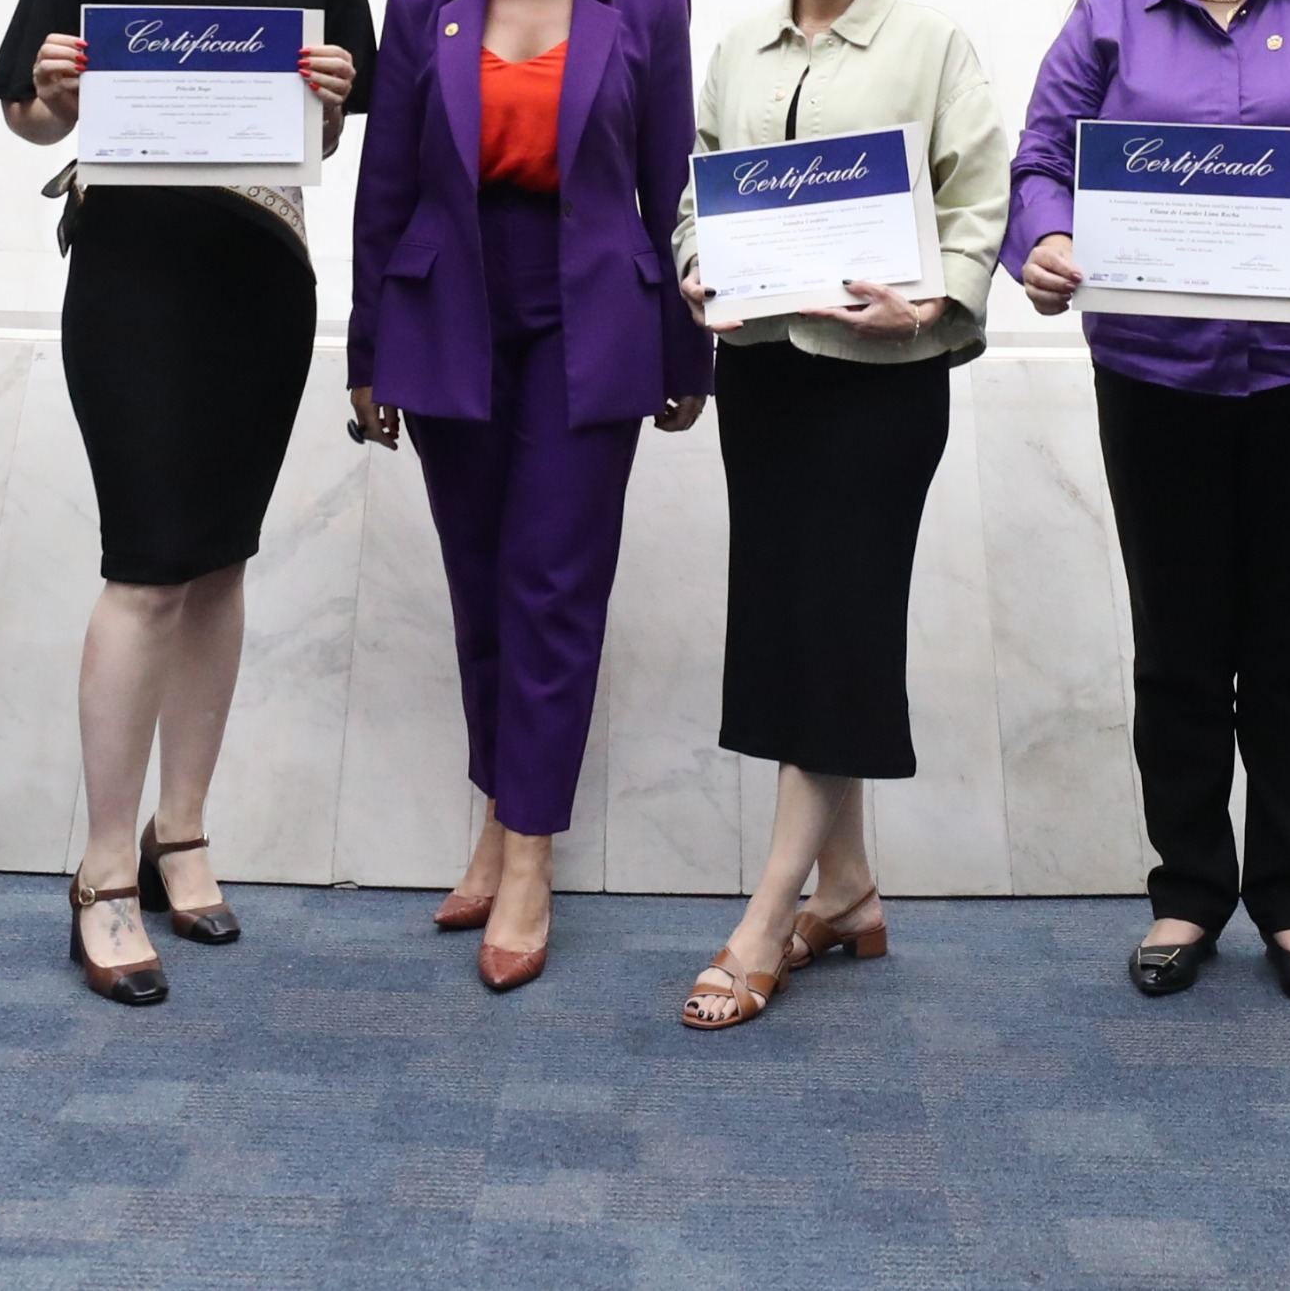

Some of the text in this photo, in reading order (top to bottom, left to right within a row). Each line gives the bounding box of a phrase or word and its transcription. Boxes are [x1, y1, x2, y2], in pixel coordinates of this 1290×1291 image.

[124, 20, 265, 64] Certificado
[733, 152, 870, 200] Certificado
[1122, 137, 1275, 187] Certificado
